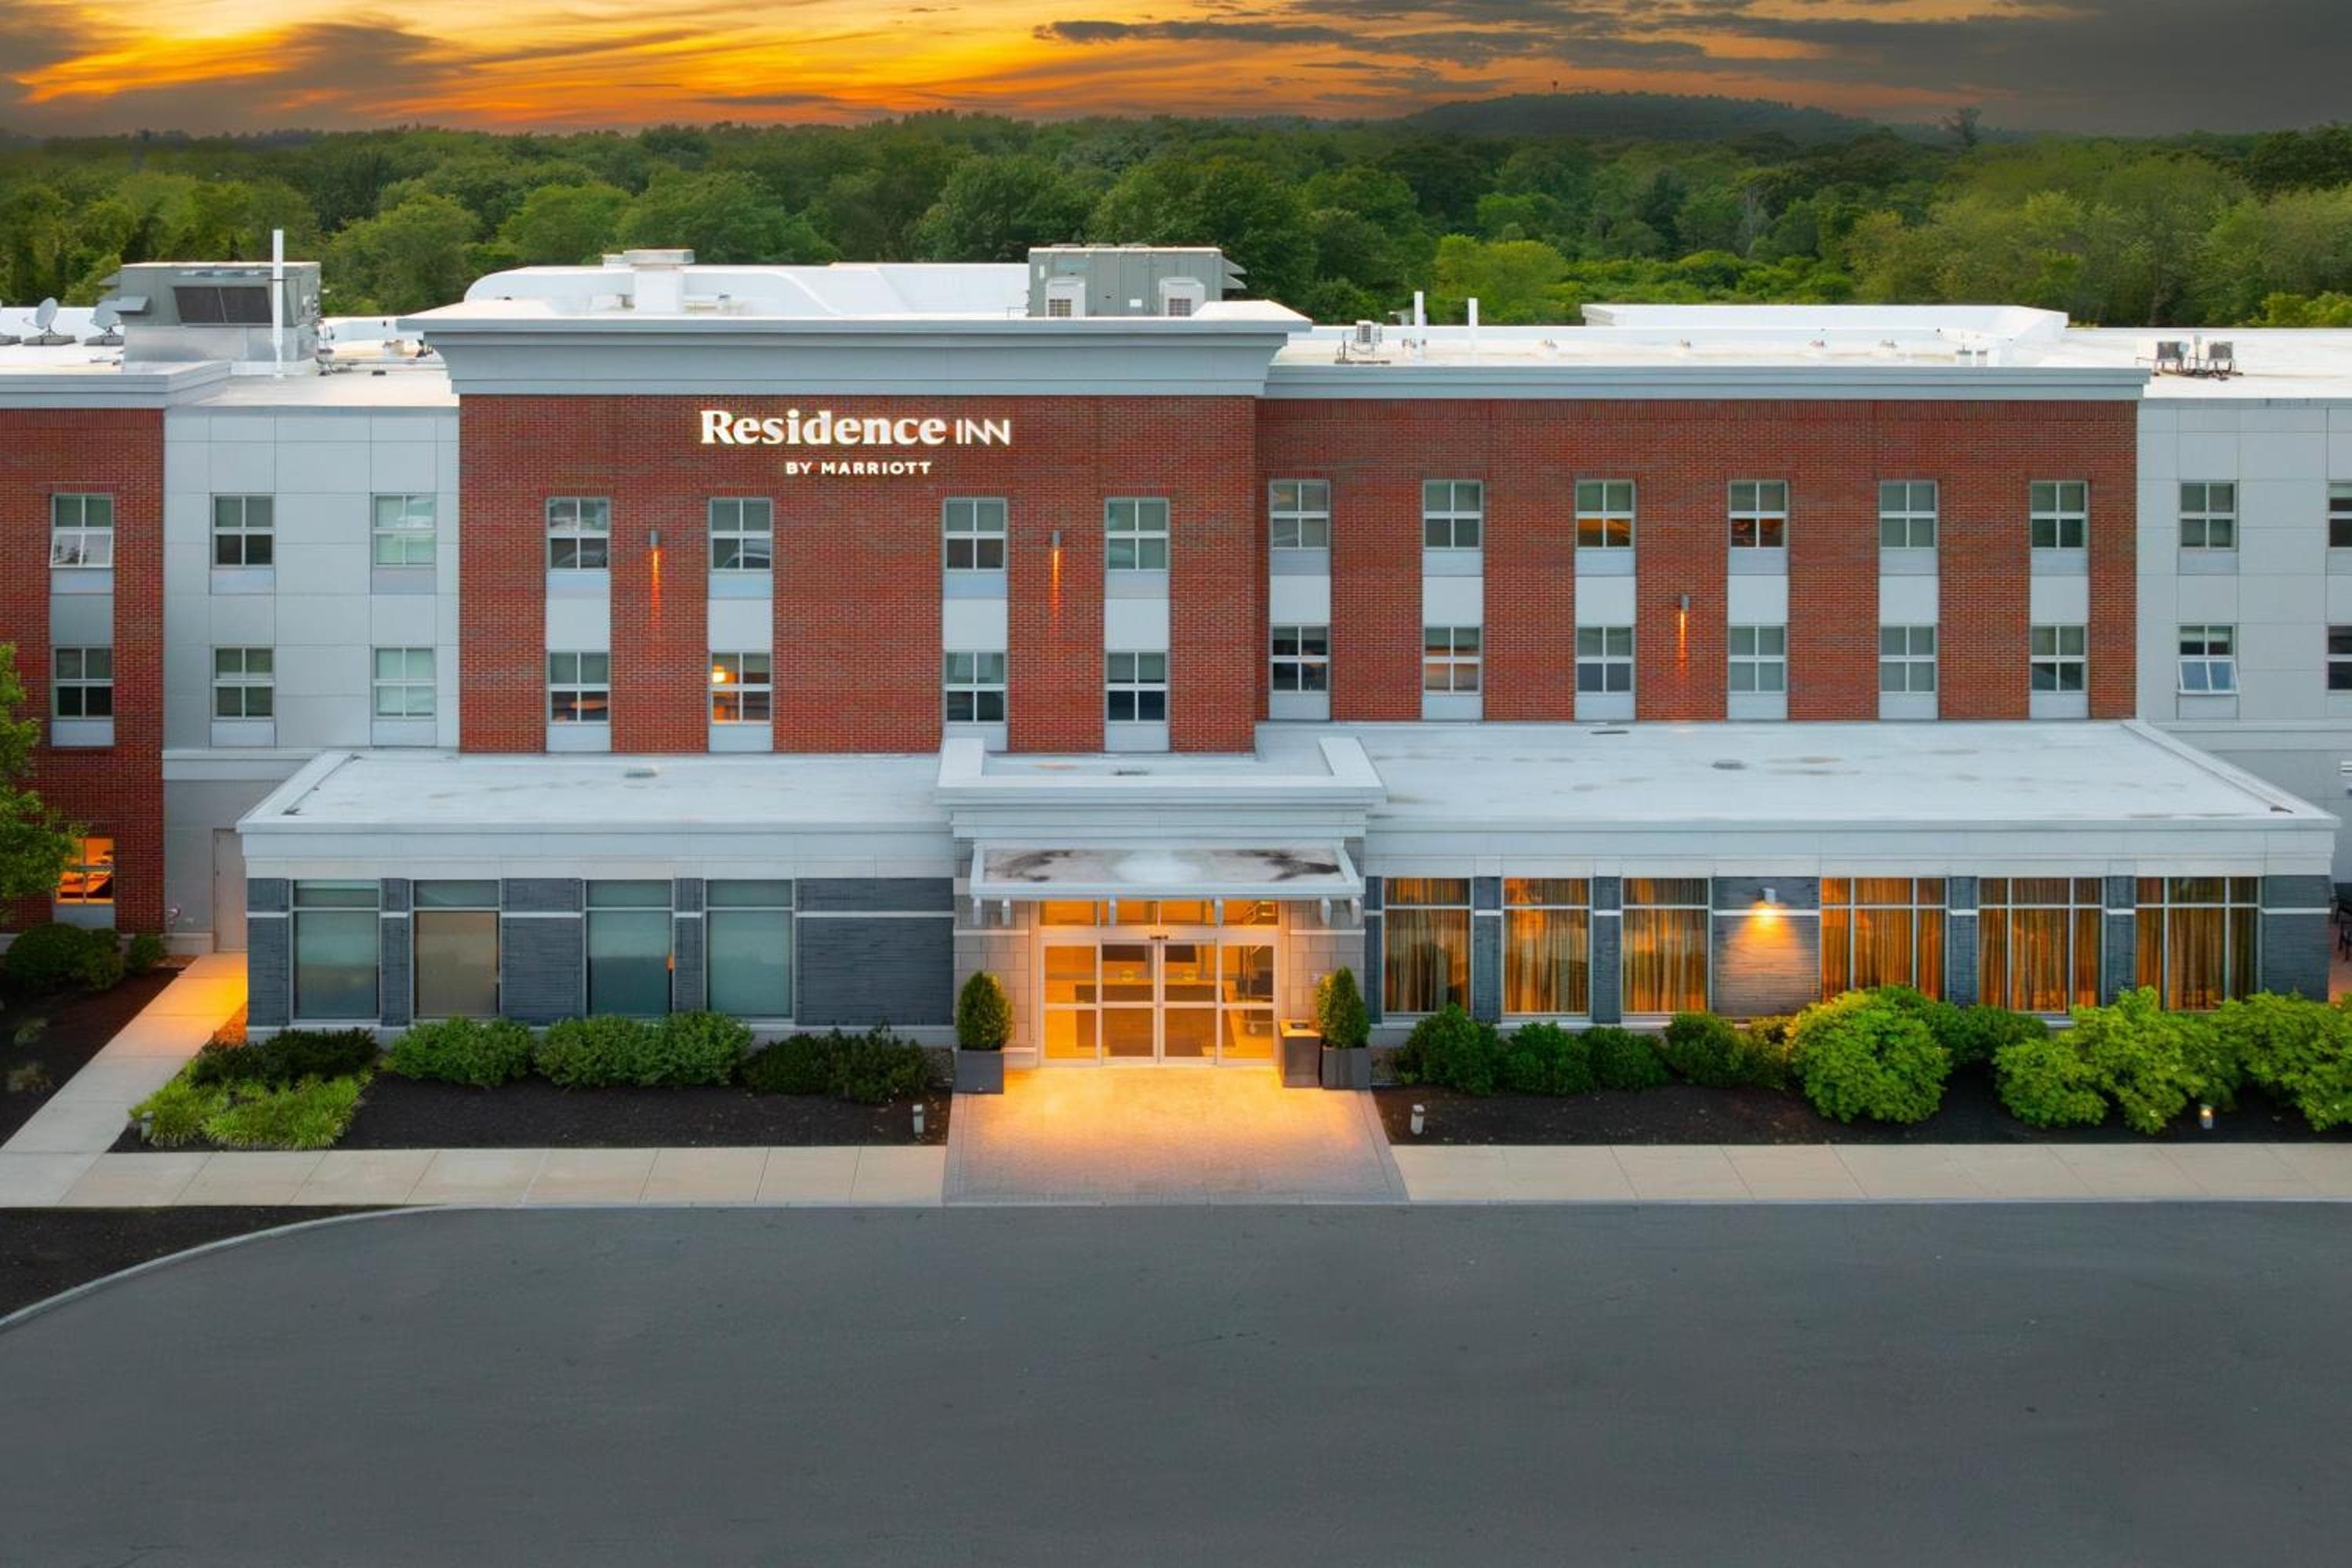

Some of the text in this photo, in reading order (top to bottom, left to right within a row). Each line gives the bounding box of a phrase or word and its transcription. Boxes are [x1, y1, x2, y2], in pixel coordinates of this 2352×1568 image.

[699, 408, 1011, 446] Residence INN
[786, 461, 932, 475] BY MARRIOTT
